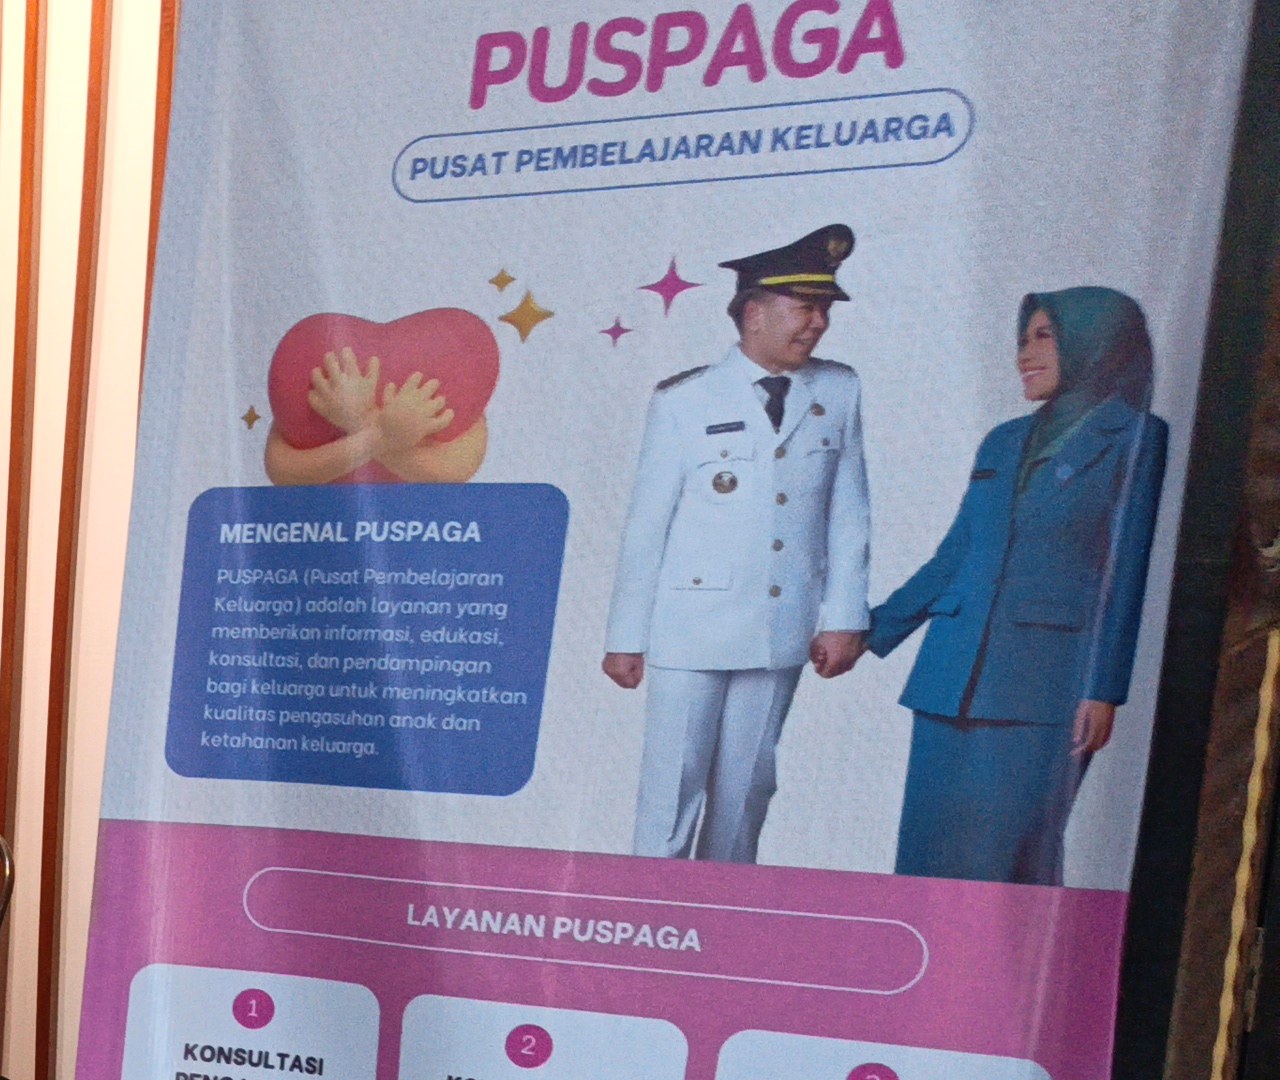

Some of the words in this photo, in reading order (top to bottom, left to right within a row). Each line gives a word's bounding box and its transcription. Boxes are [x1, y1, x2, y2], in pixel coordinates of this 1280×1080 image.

[468, 0, 906, 110] PUSPAGA
[409, 150, 511, 182] PUSAT
[515, 129, 763, 175] PEMBELAJARAN
[770, 112, 958, 154] KELUARGA
[219, 522, 348, 544] MENGENAL
[355, 521, 481, 543] PUSPAGA
[217, 568, 298, 585] PUSPAGA
[303, 569, 359, 587] (Pusat
[364, 570, 504, 589] Pembelajaran
[214, 597, 301, 615] Keluarga)
[305, 598, 366, 614] adalah
[371, 598, 452, 618] layanan
[456, 602, 508, 619] yang
[212, 625, 321, 641] memberikan
[324, 625, 415, 643] informasi,
[420, 629, 504, 647] edukasi,
[208, 652, 303, 670] konsultasi,
[307, 654, 340, 670] dan
[342, 655, 492, 676] pendampingan
[206, 678, 247, 696] bagi
[250, 679, 324, 699] keluarga
[329, 682, 378, 699] untuk
[382, 684, 528, 706] meningkatkan
[203, 704, 276, 722] kualitas
[279, 708, 386, 729] pengasuhan
[388, 712, 437, 729] anak
[442, 714, 481, 732] dan
[201, 731, 297, 750] ketahanan
[301, 734, 380, 757] keluarga.
[406, 904, 546, 938] LAYANAN
[552, 916, 702, 952] PUSPAGA
[246, 1000, 258, 1017] 1
[521, 1035, 537, 1055] 2
[183, 1043, 325, 1076] KONSULTASI
